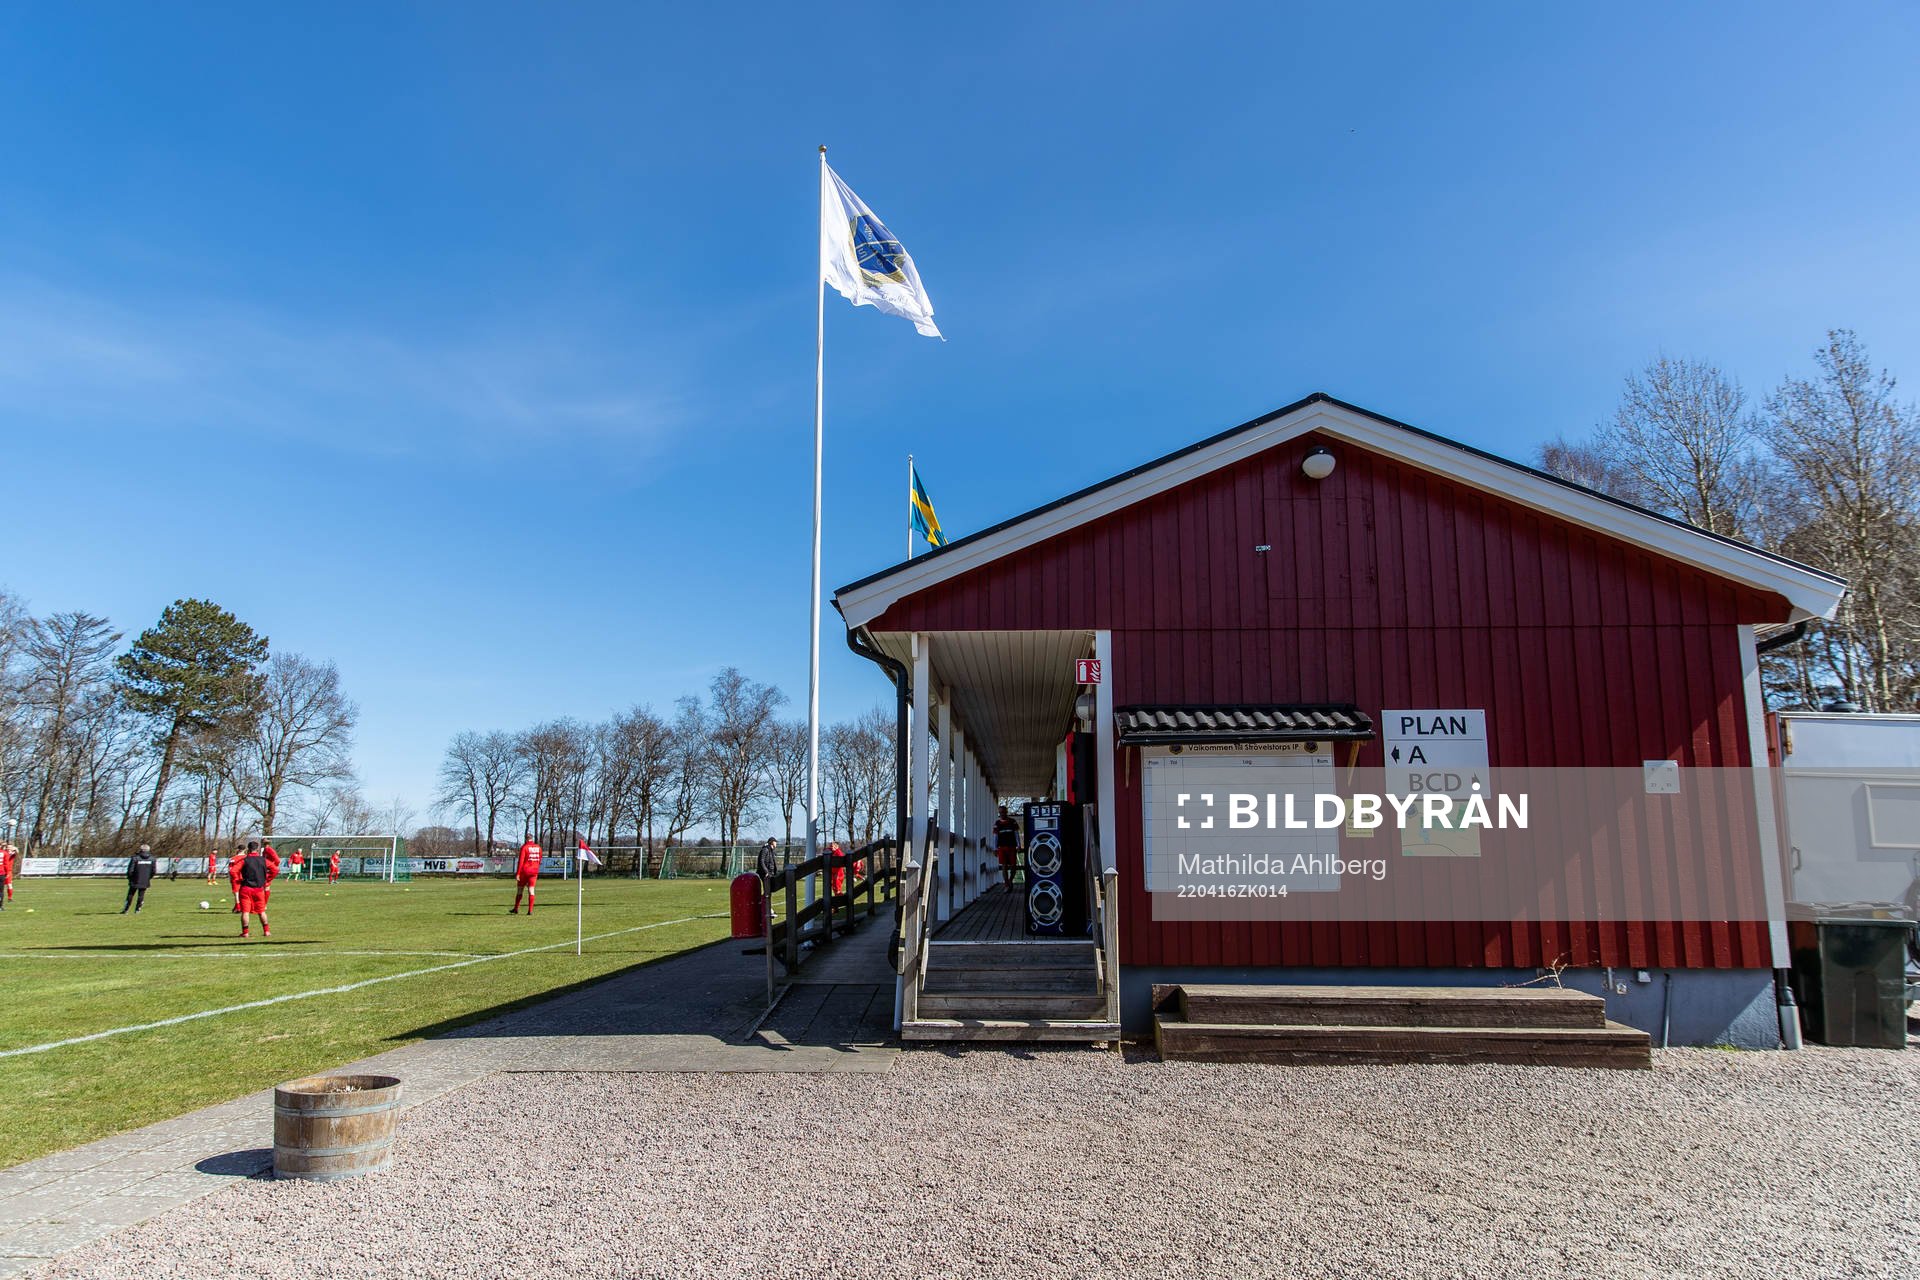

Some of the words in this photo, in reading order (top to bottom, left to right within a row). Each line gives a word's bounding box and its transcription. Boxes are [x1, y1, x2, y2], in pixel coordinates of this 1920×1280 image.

[1401, 716, 1467, 735] PLAN
[1408, 746, 1427, 764] A
[1409, 773, 1462, 792] BCD
[424, 860, 446, 870] MVB
